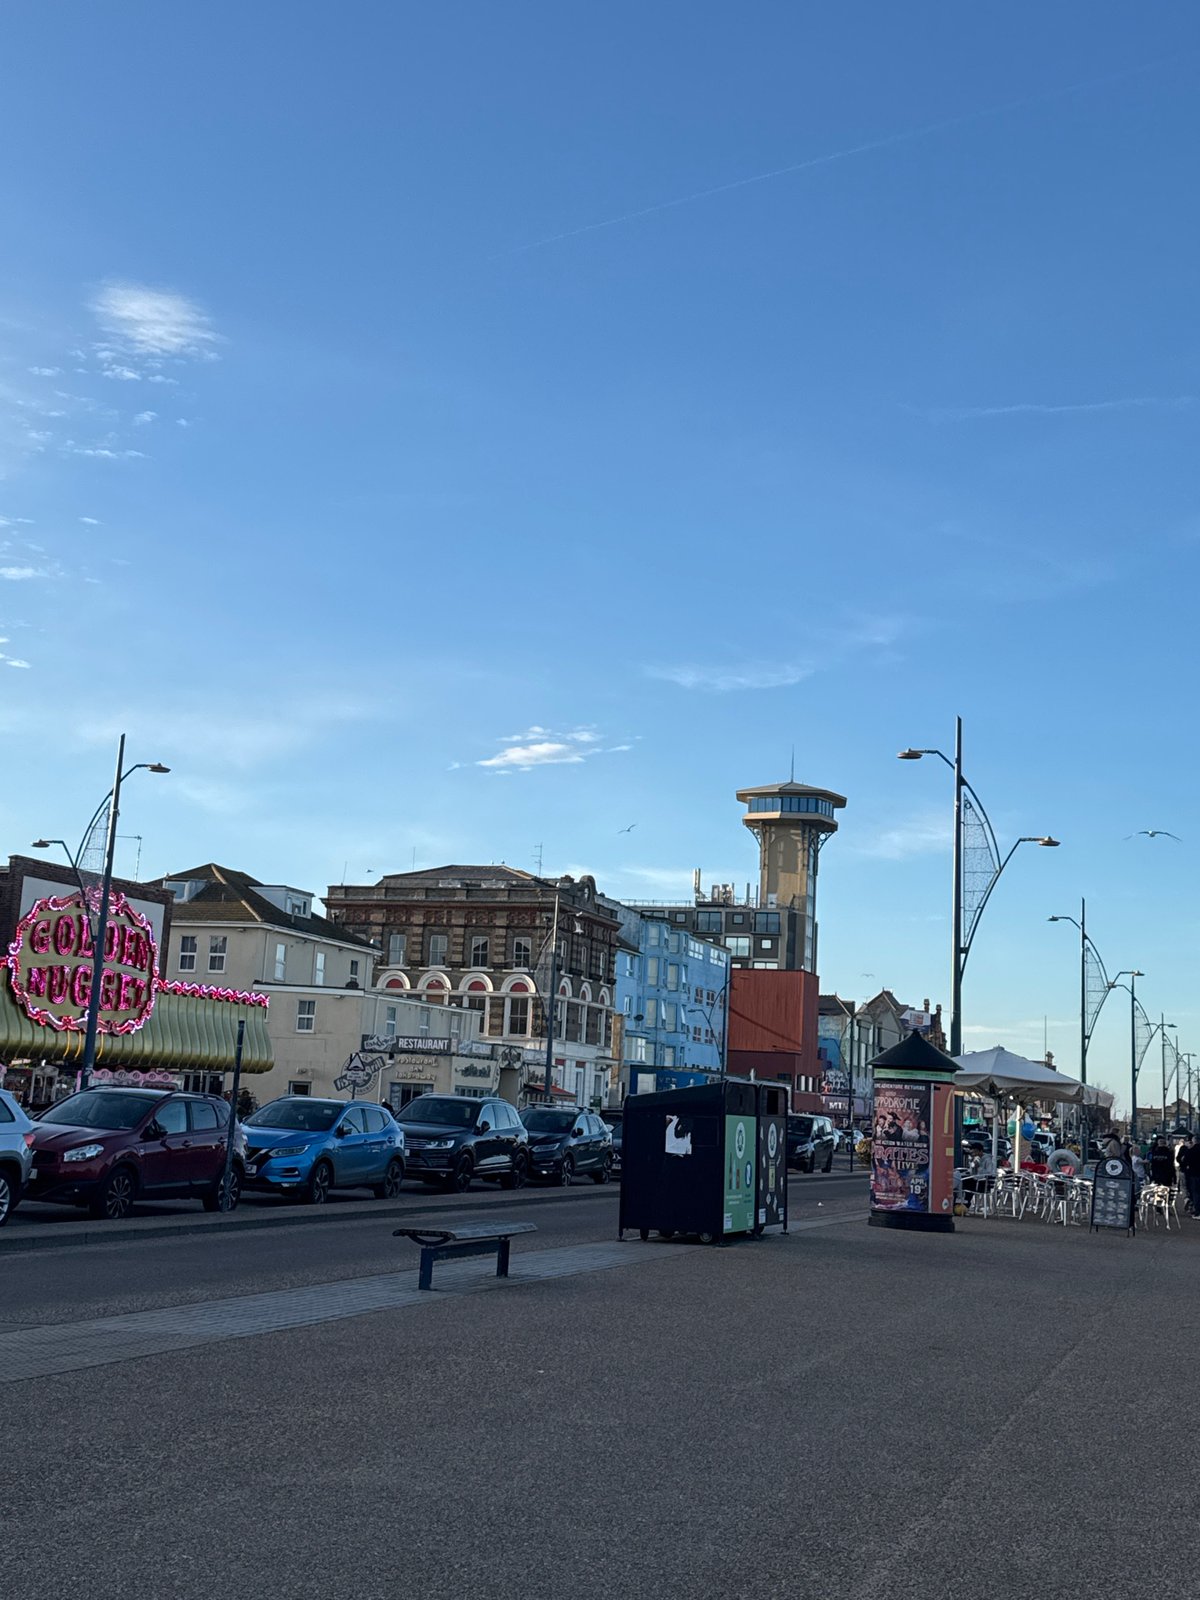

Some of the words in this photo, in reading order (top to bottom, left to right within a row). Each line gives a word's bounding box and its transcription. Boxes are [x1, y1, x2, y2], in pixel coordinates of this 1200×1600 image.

[30, 914, 149, 972] GOLDEN
[27, 964, 146, 1011] NUGGET
[398, 1037, 449, 1050] RESTAURANT
[910, 1184, 922, 1194] 19
